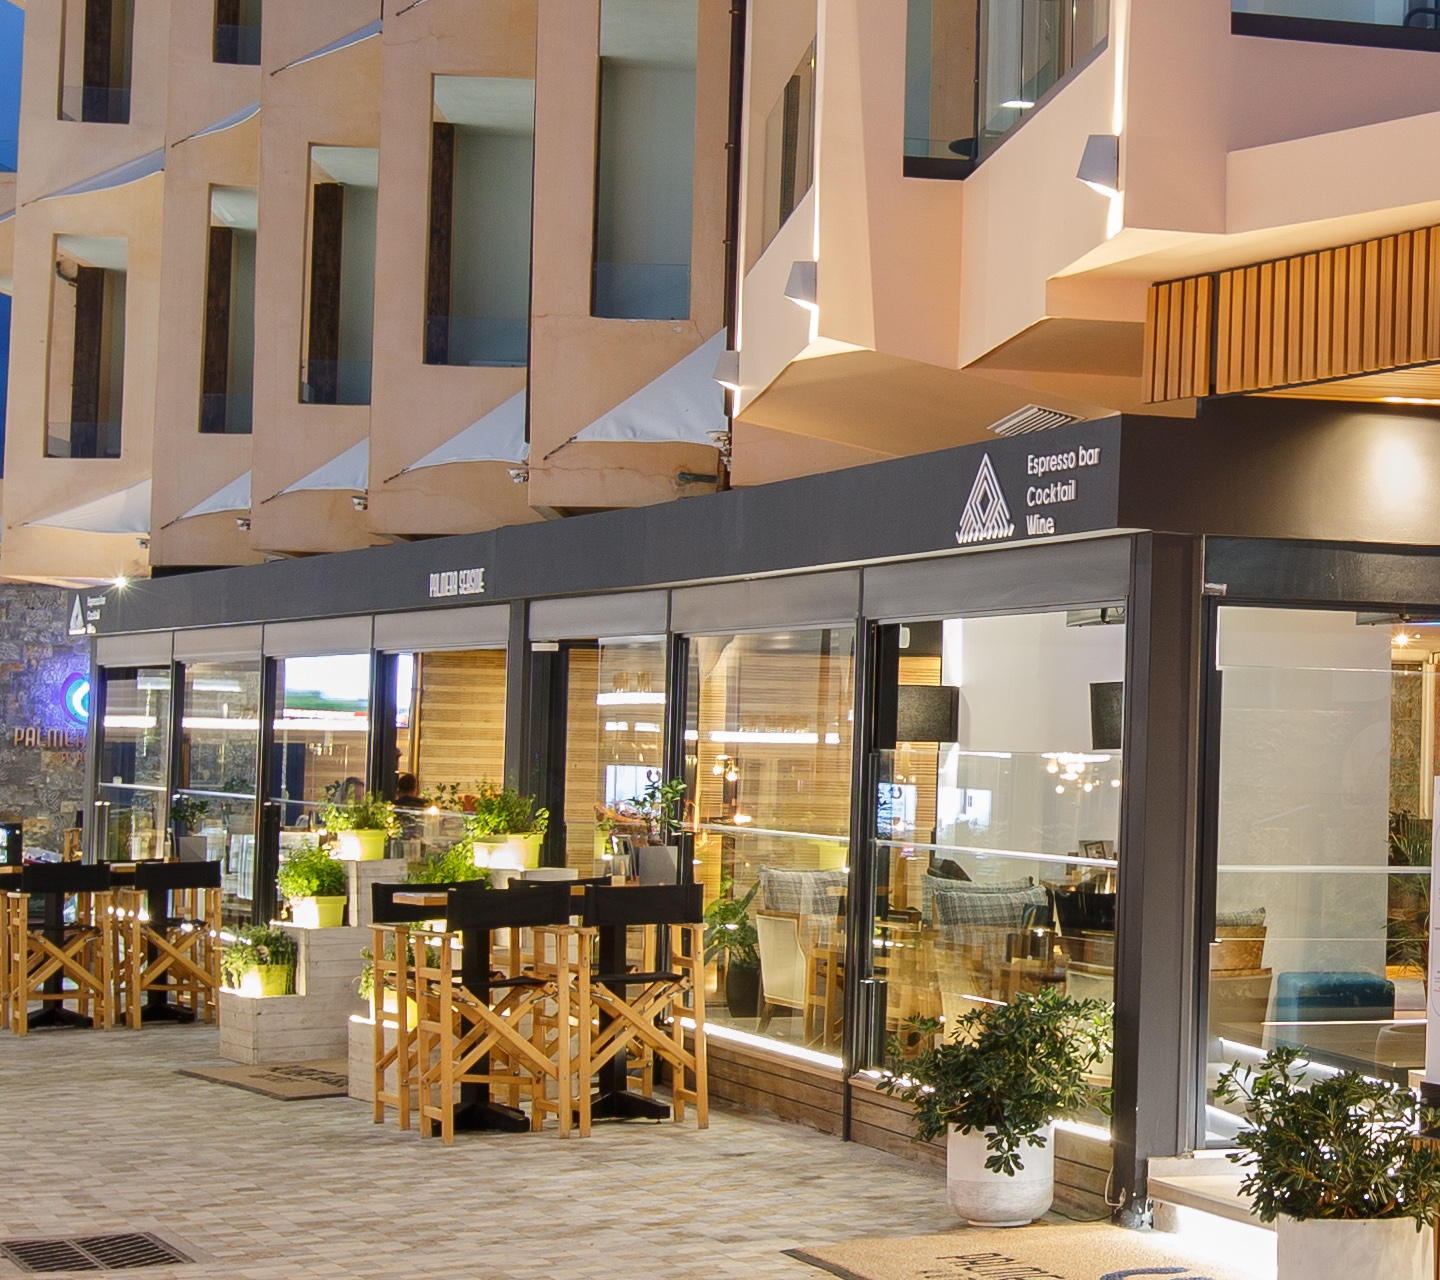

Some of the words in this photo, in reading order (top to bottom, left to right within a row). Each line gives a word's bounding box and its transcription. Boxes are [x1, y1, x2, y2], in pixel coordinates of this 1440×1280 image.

[1026, 451, 1076, 477] Espresso
[1078, 445, 1101, 467] bar
[1026, 479, 1077, 507] Cocktail
[1026, 514, 1055, 535] Wine
